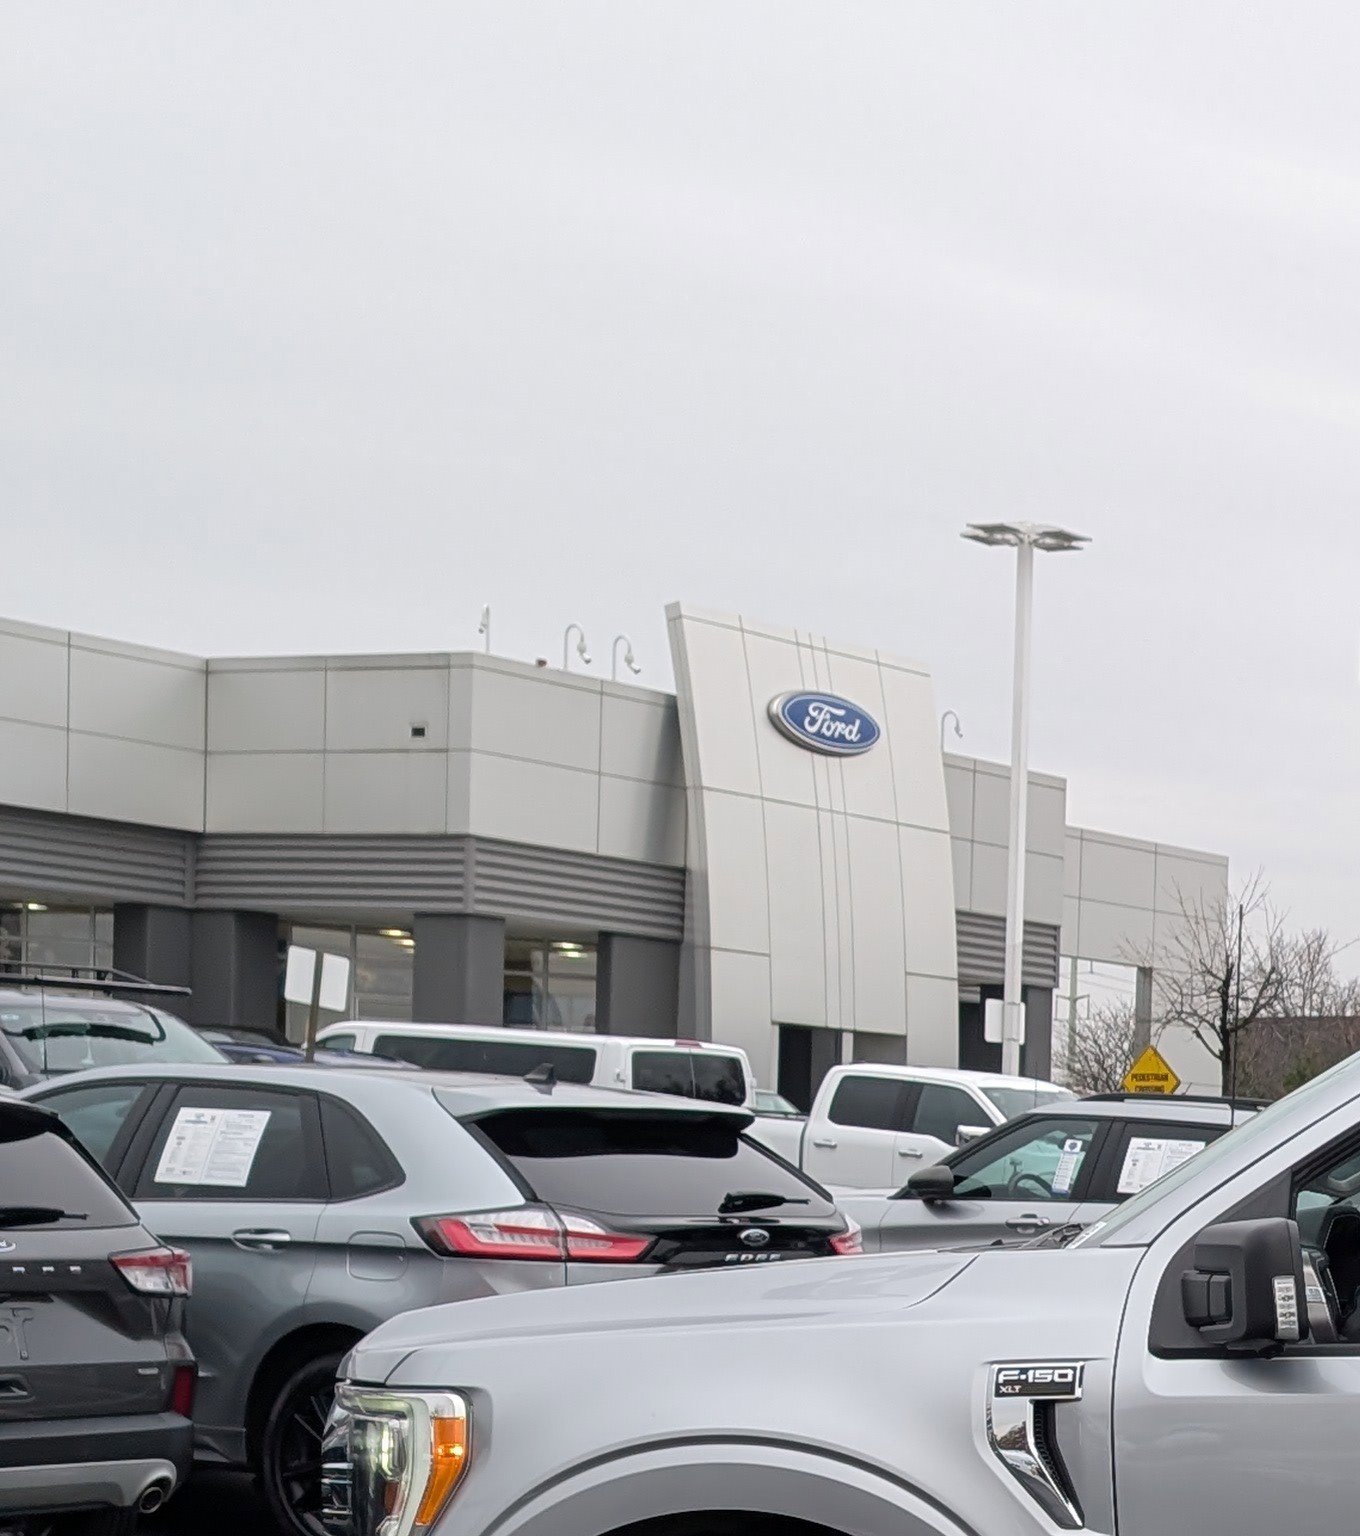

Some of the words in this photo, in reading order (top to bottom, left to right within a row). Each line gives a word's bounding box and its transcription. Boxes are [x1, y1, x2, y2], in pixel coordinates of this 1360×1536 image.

[803, 702, 861, 742] Ford
[998, 1369, 1075, 1384] F-150
[999, 1385, 1022, 1393] XLT
